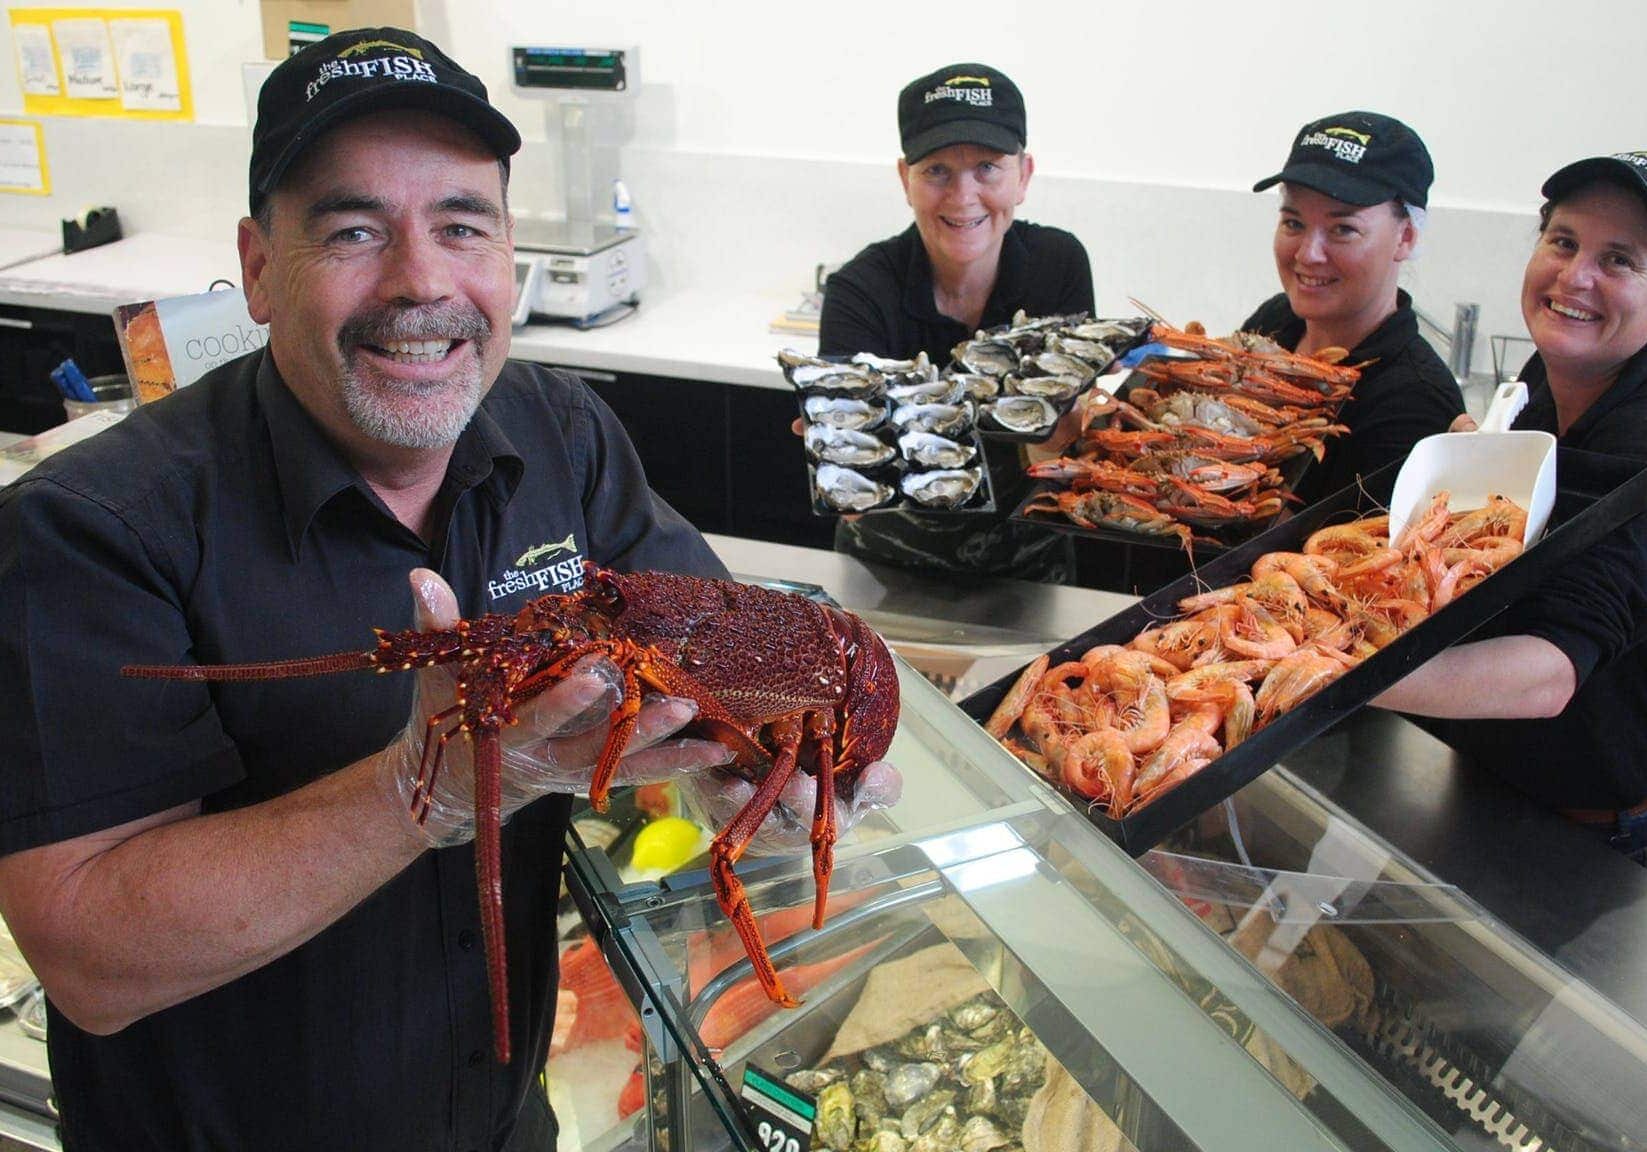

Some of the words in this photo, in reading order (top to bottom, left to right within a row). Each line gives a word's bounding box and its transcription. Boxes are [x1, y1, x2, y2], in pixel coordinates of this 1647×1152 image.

[319, 60, 339, 74] the
[306, 56, 437, 102] freshFISH
[394, 73, 438, 83] PLACE
[488, 555, 585, 600] freshFISH
[503, 569, 519, 581] the
[561, 577, 585, 593] PLAC
